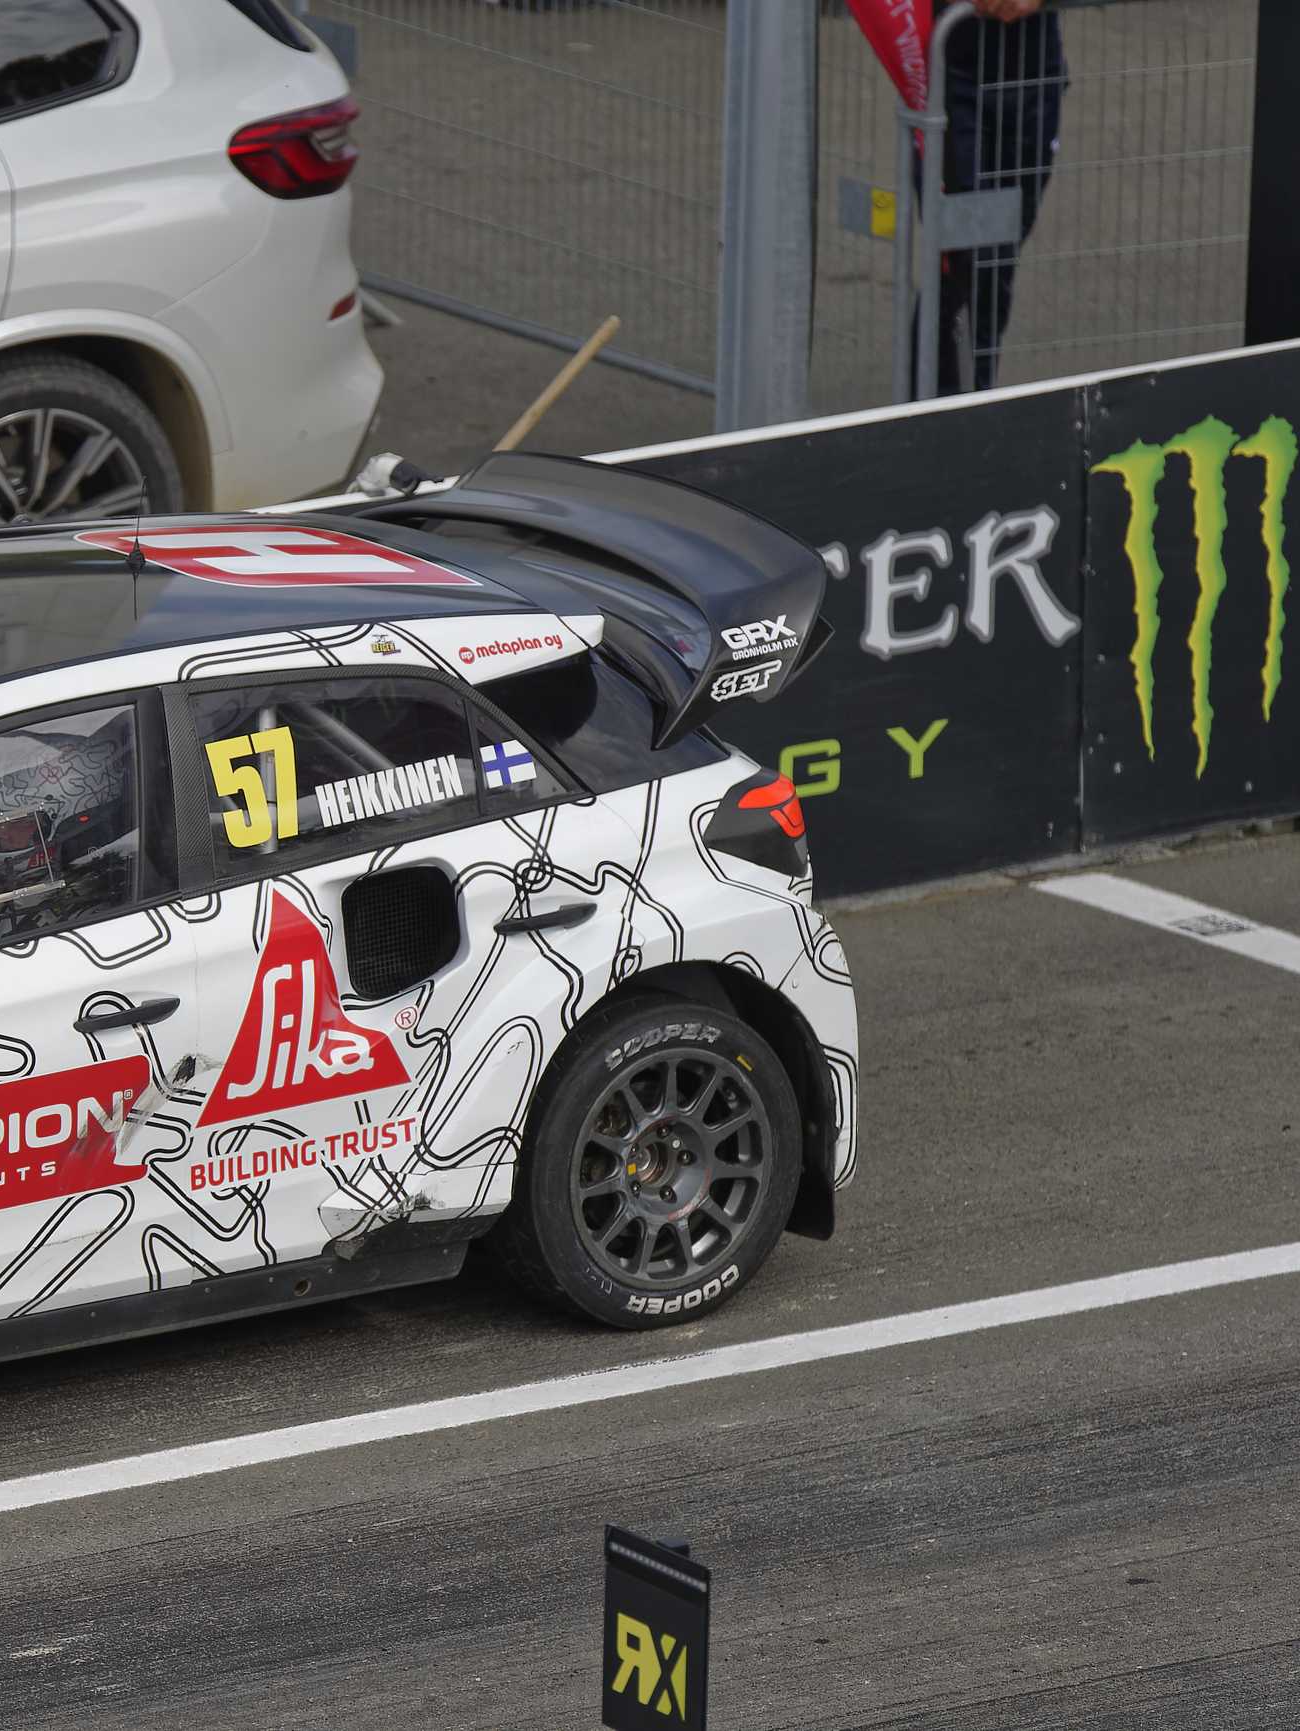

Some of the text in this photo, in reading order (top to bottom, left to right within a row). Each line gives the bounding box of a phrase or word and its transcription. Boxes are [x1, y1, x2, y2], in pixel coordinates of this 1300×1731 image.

[476, 633, 564, 659] metaplan oy
[720, 614, 797, 650] GRX
[782, 636, 799, 650] RX
[203, 726, 300, 849] 57
[314, 753, 464, 828] HEIKKINEN
[227, 959, 375, 1100] Sika
[190, 1117, 417, 1191] BUILDING TRUST
[627, 1264, 740, 1314] COOPER
